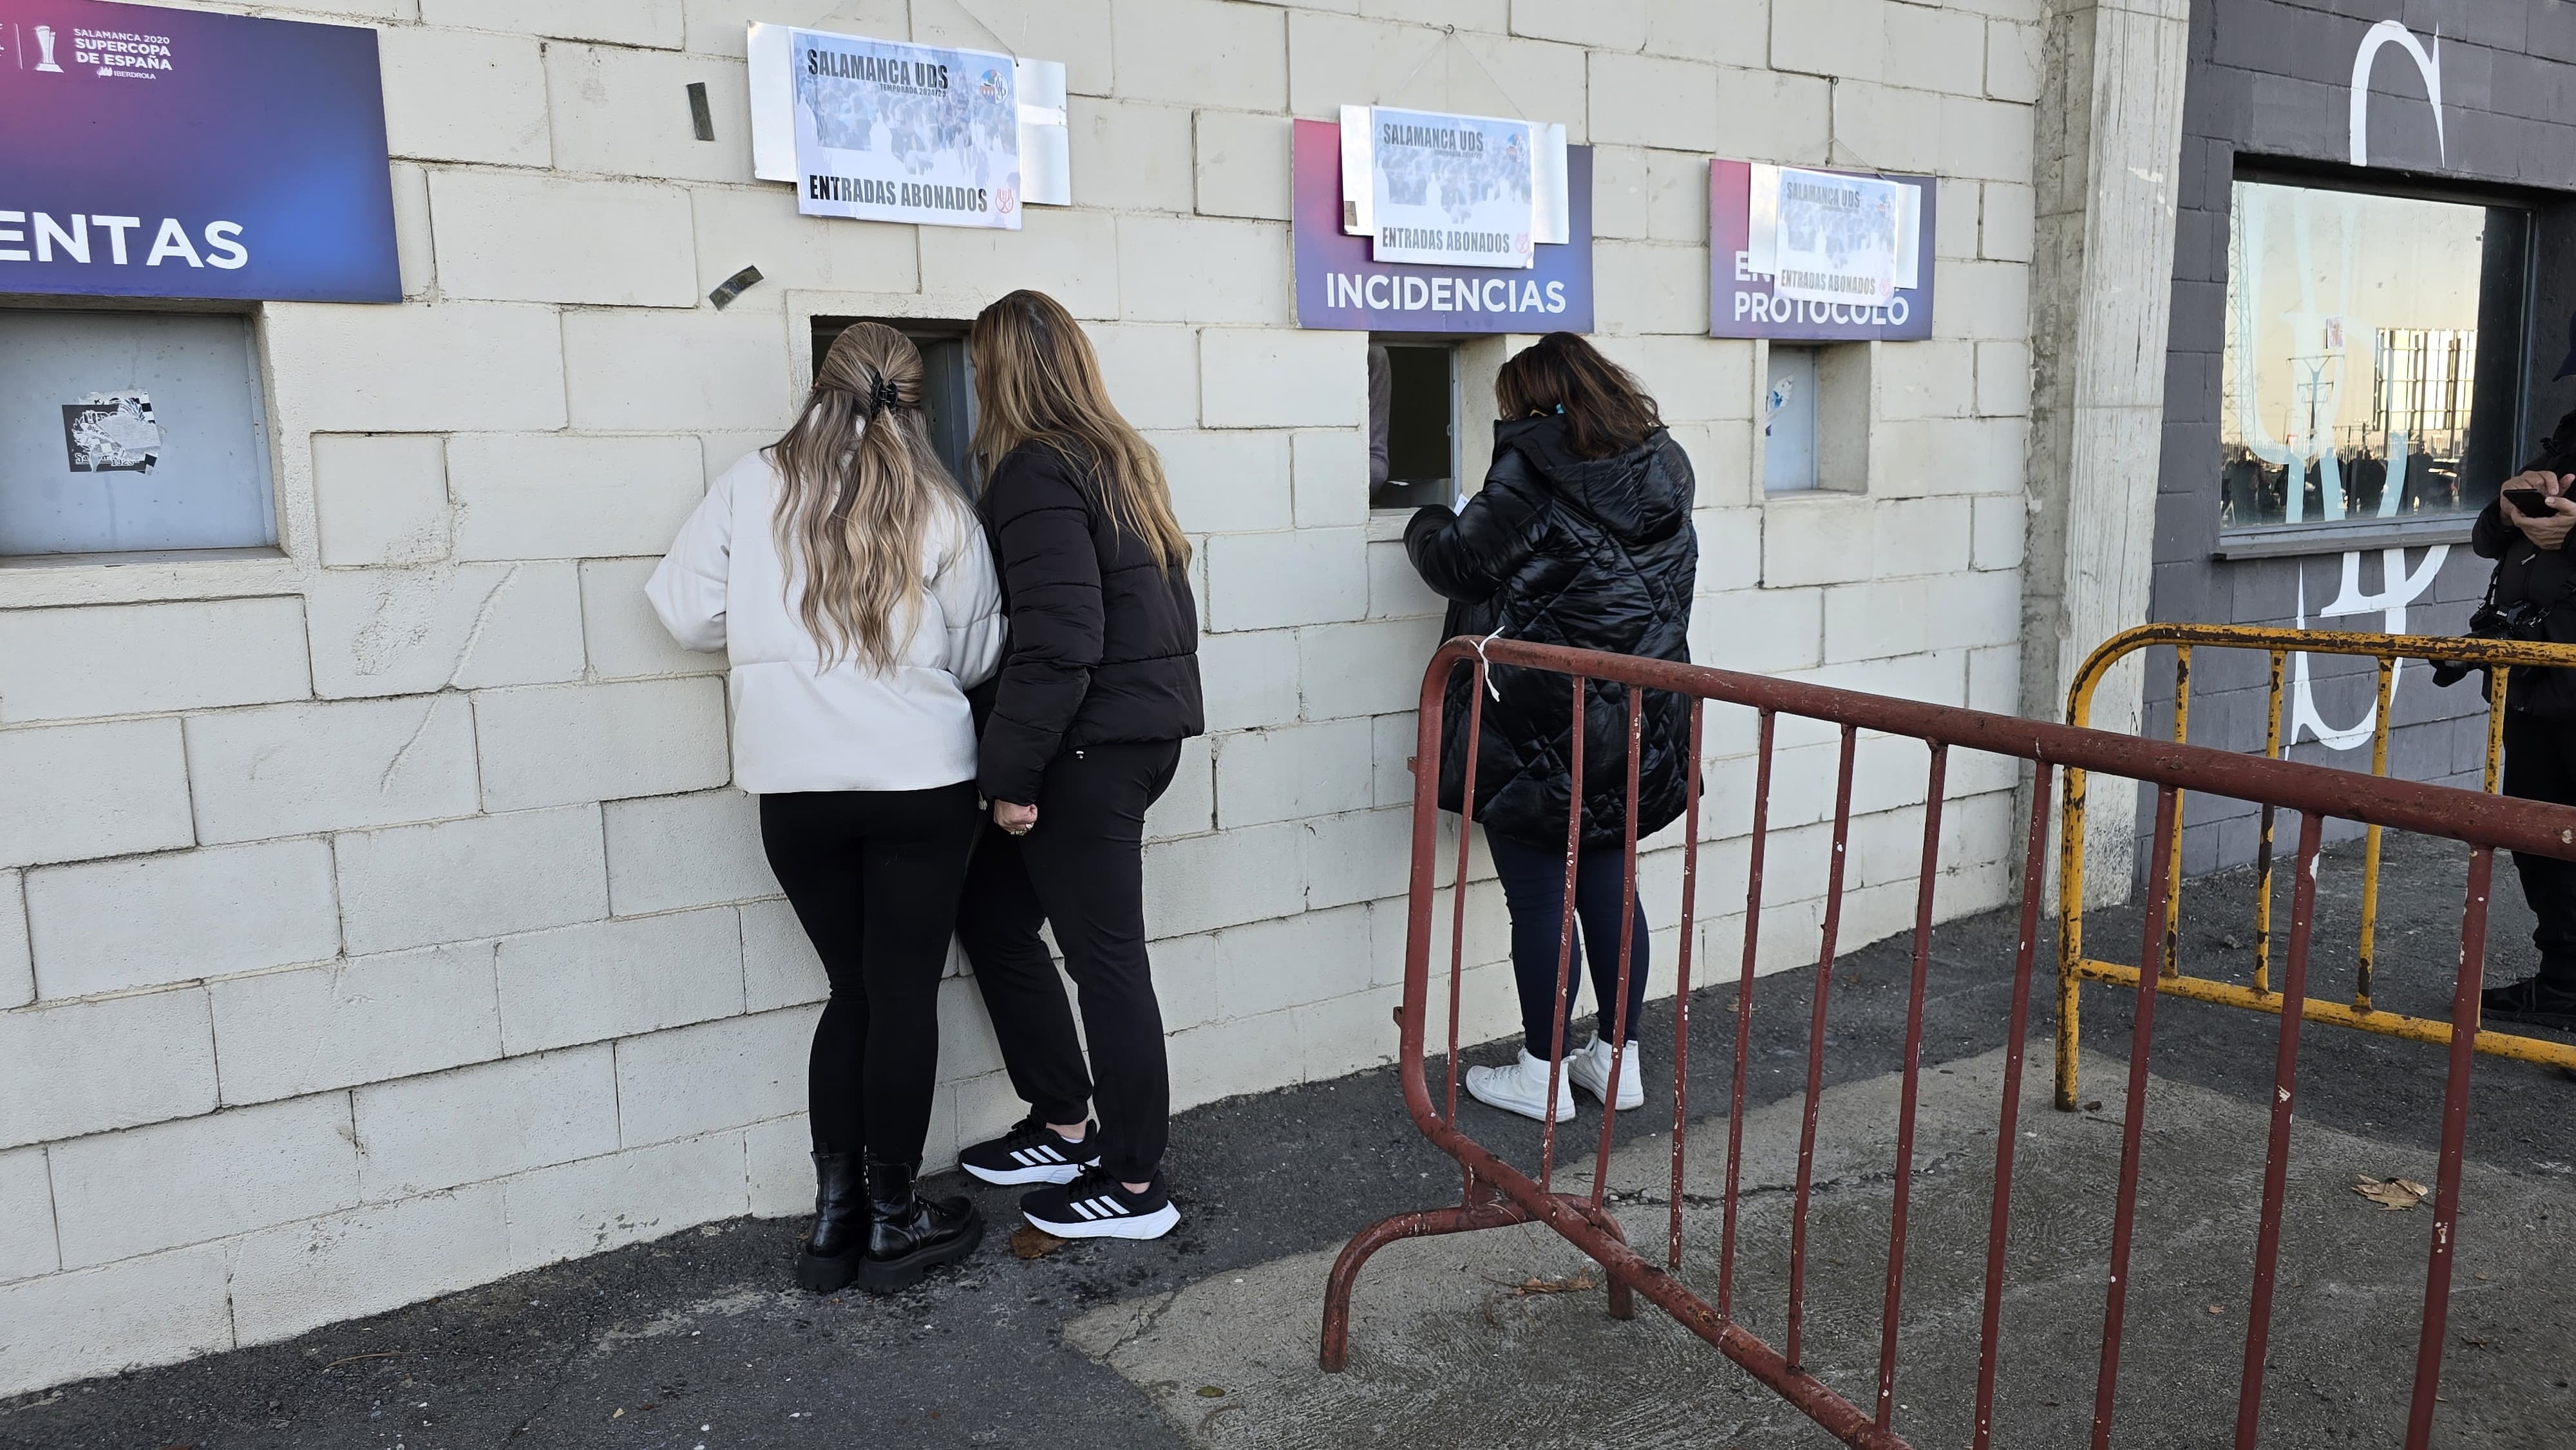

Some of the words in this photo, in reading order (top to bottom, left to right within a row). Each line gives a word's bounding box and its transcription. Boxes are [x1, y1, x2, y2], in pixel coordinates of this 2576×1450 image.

[74, 28, 142, 42] SALAMANCA
[144, 35, 171, 44] 2020
[75, 37, 171, 57] SUPERCOPA
[76, 51, 100, 64] DE
[104, 53, 173, 70] ESPAÑA
[806, 49, 911, 86] SALAMANCA
[915, 62, 949, 89] UDS
[114, 70, 156, 80] IBERDROLA
[880, 84, 918, 95] TEMPORADA
[919, 88, 947, 98] 2024/25
[1383, 123, 1455, 150] SALAMANCA
[1459, 131, 1484, 152] UDS
[810, 175, 896, 207] ENTRADAS
[901, 182, 988, 212] ABONADOS
[1787, 182, 1839, 205] SALAMANCA
[1842, 190, 1861, 209] UDS
[1382, 227, 1443, 250] ENTRADAS
[1446, 231, 1510, 254] ABONADOS
[1327, 272, 1566, 314] INCIDENCIAS
[1781, 269, 1826, 291] ENTRADAS
[1828, 275, 1876, 295] ABONADOS
